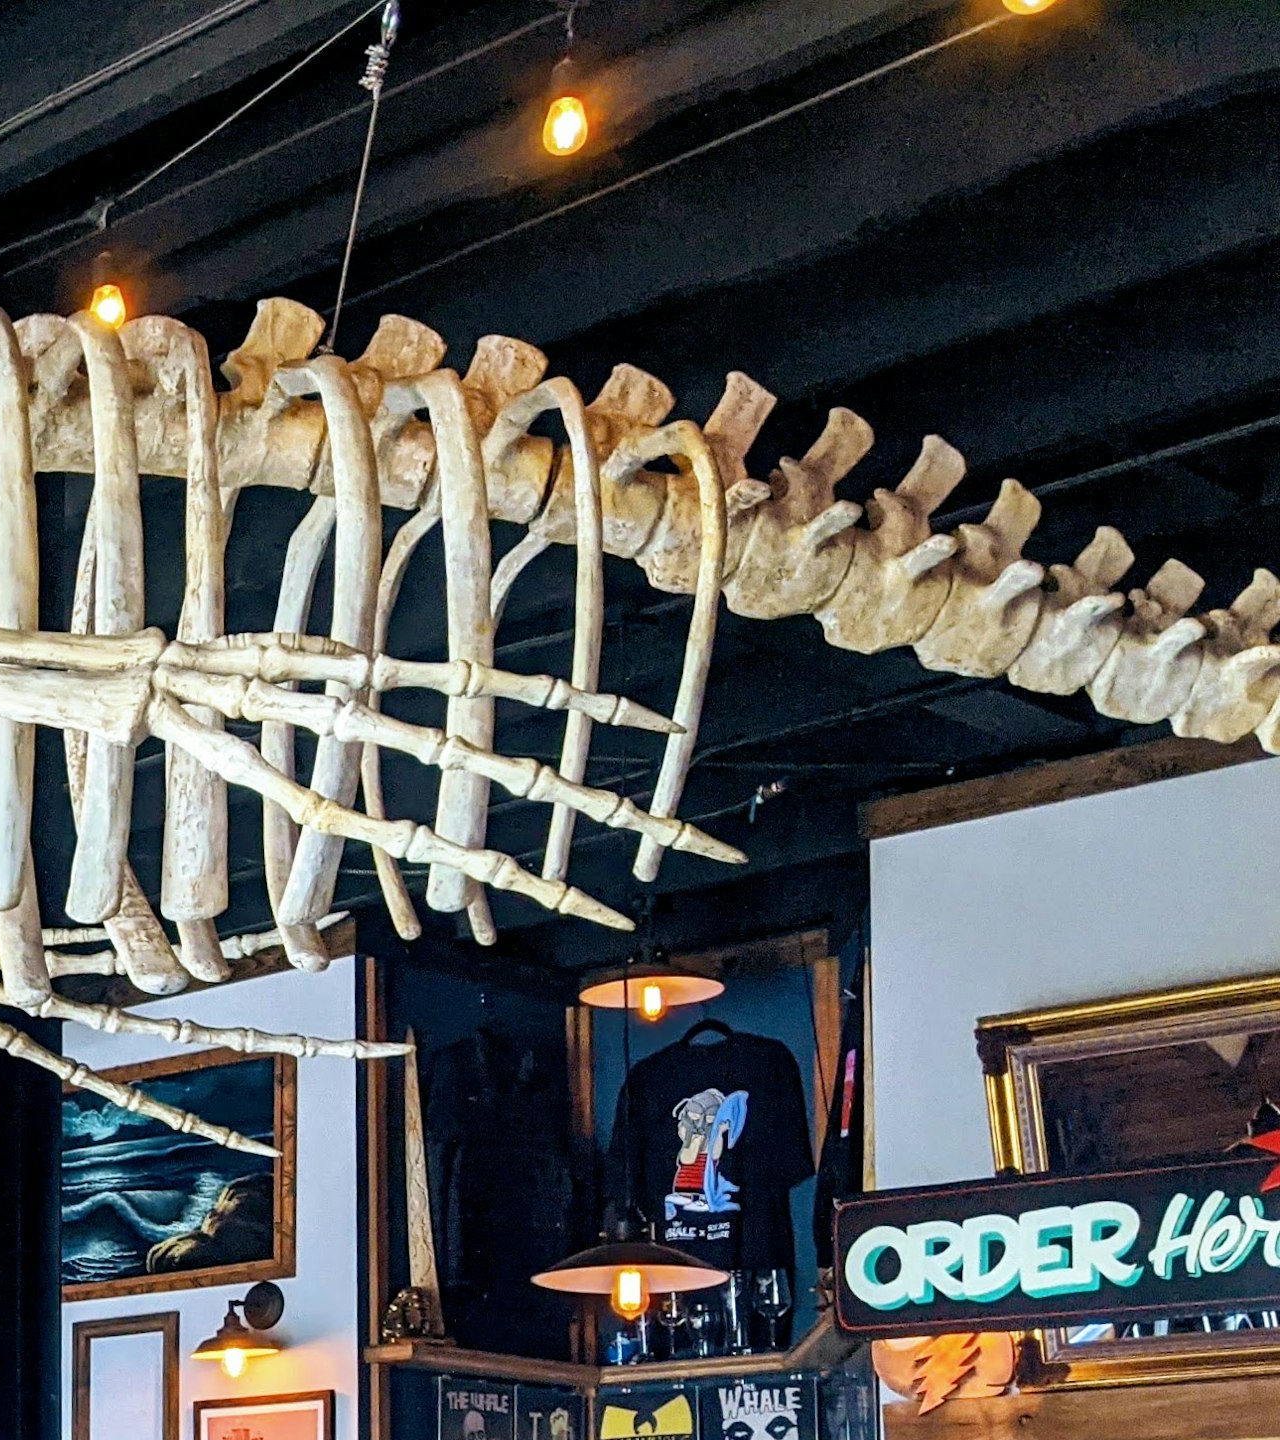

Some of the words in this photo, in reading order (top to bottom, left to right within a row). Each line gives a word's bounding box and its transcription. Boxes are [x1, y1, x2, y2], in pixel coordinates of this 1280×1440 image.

[845, 1200, 1143, 1310] ORDER
[446, 1391, 469, 1410] THE
[470, 1392, 509, 1414] WHALE
[718, 1386, 802, 1420] WHALE
